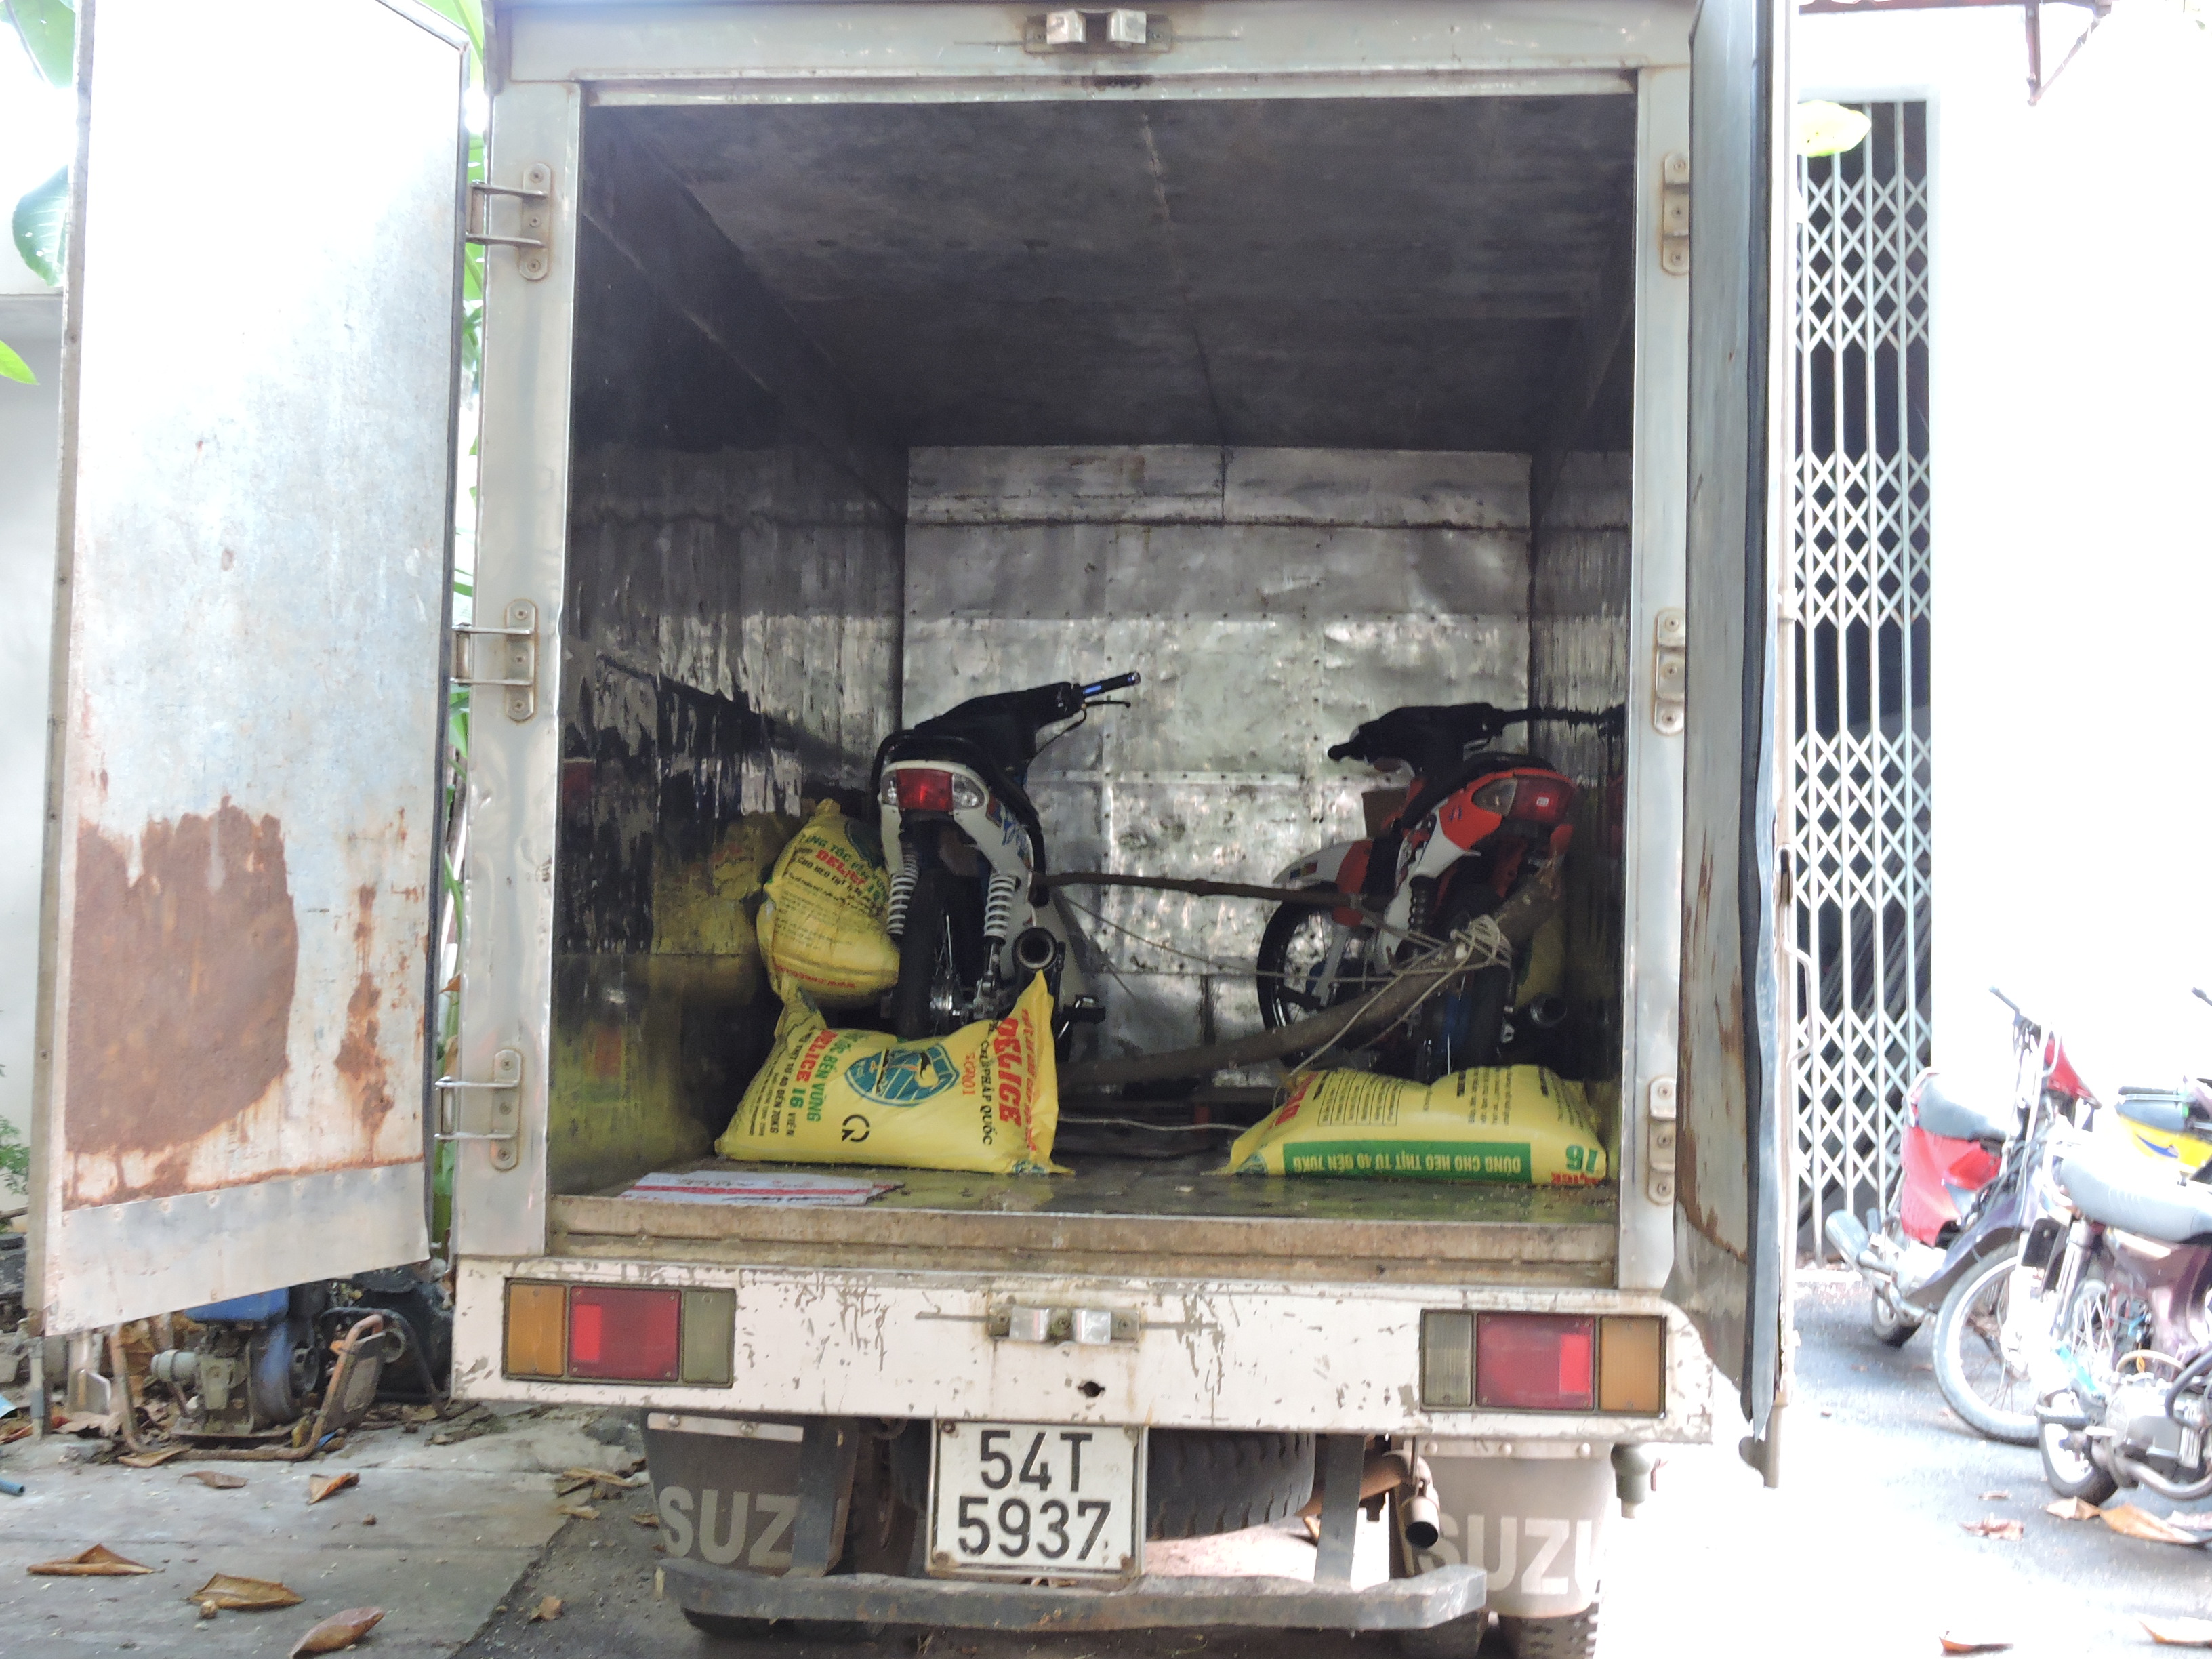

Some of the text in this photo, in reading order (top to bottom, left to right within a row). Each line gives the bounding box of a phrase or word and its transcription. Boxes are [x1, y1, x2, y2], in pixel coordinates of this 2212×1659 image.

[994, 1017, 1023, 1127] DELICE
[790, 1088, 807, 1109] 16
[806, 1083, 828, 1122] VỮNG
[980, 1105, 998, 1145] QUỐC
[1425, 1153, 1452, 1172] HEO
[1454, 1154, 1482, 1172] CHO
[1565, 1143, 1599, 1174] 16
[979, 1429, 1094, 1493] 54T
[956, 1496, 1112, 1561] 5937
